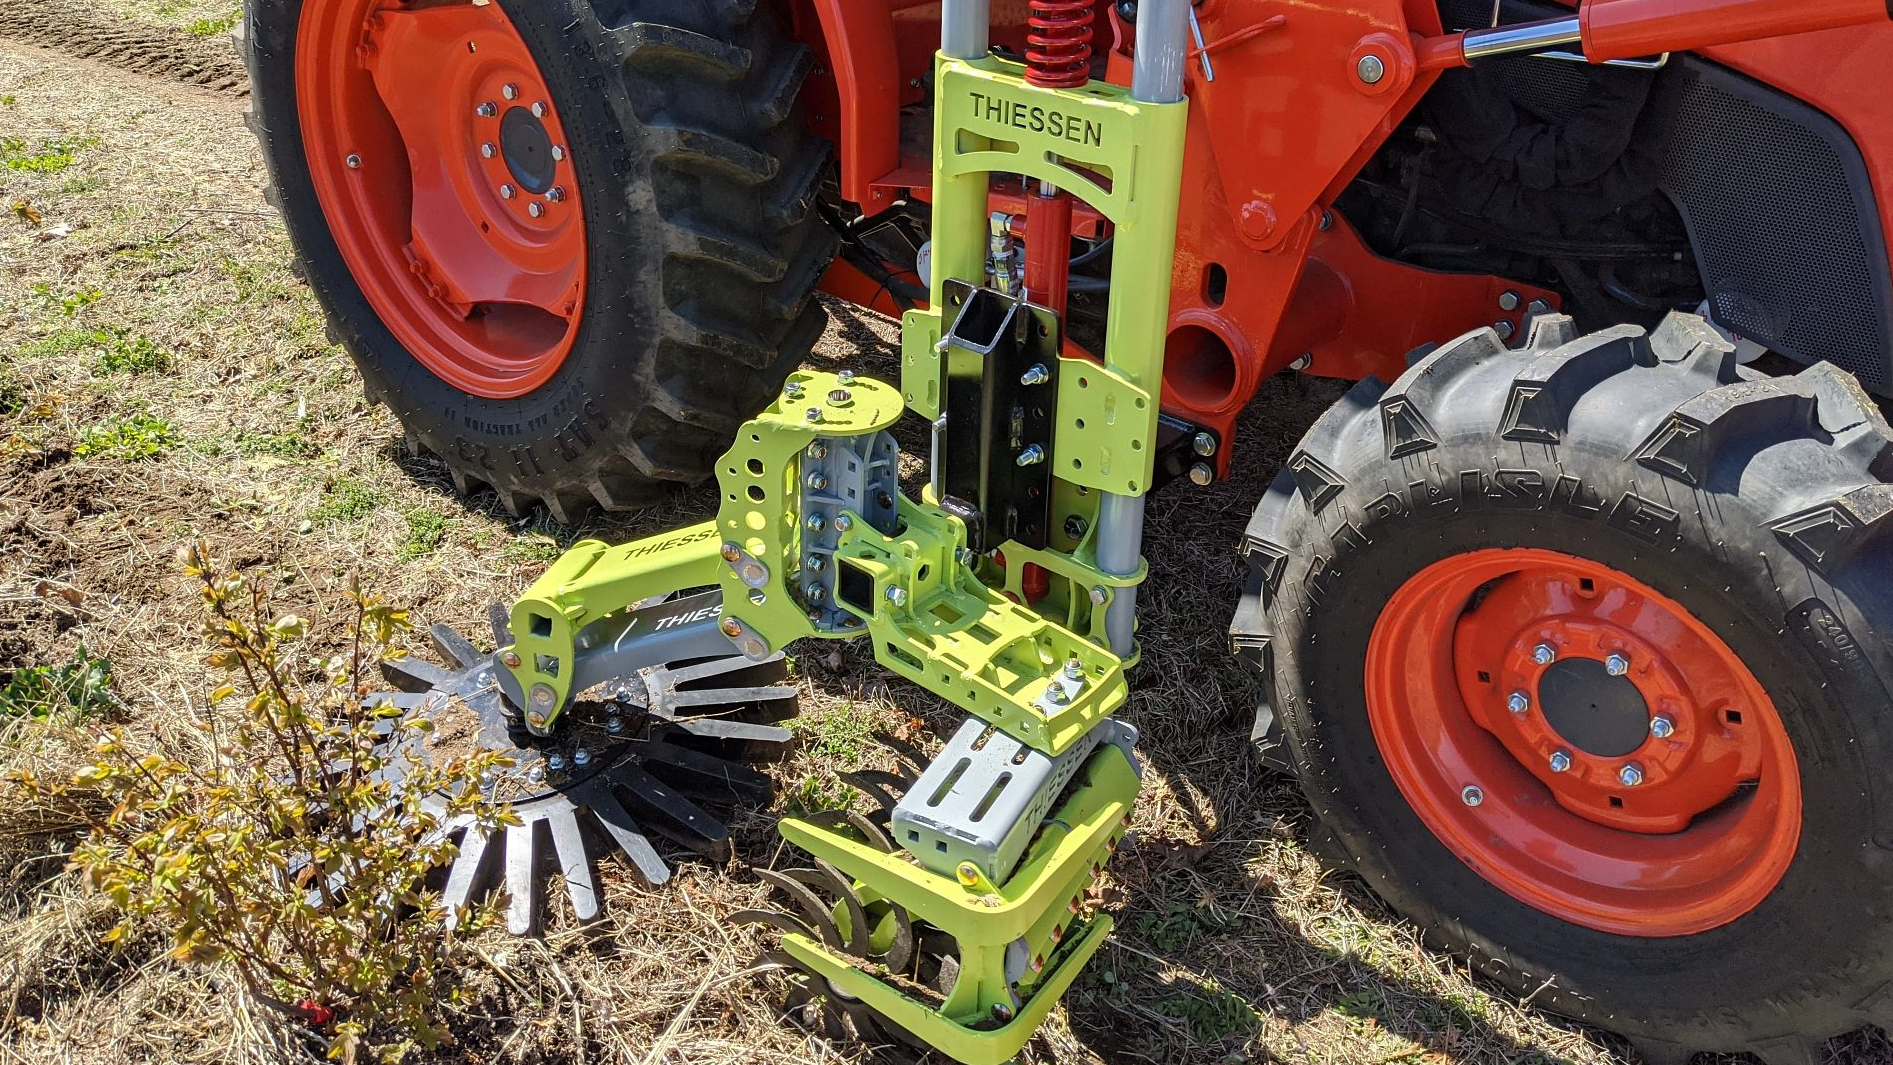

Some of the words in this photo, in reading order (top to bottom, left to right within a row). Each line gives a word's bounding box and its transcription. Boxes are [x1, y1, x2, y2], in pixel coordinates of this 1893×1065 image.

[970, 92, 1102, 147] THIESSEN
[624, 529, 721, 561] THIESSE
[655, 604, 724, 631] THIES
[1025, 731, 1092, 834] THIESSEN
